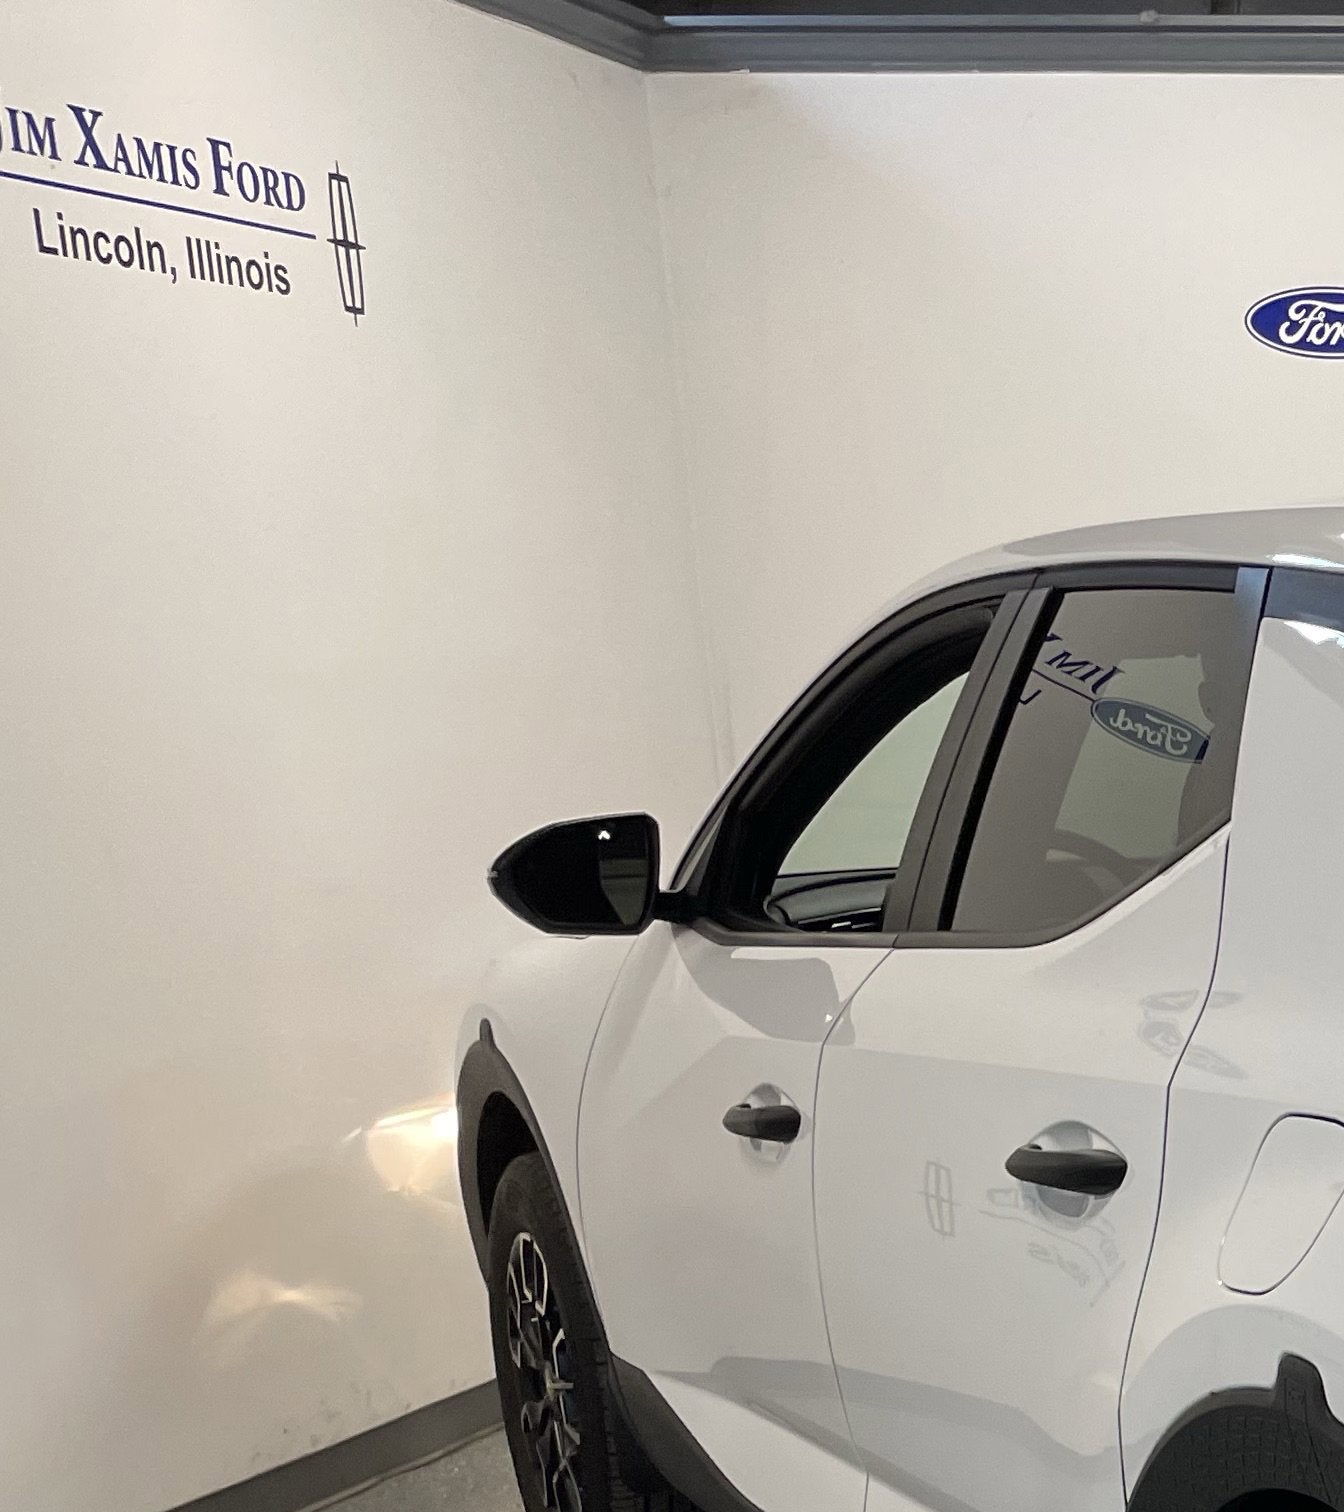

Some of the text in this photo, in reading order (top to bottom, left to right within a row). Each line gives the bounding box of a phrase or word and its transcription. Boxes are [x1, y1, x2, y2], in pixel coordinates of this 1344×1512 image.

[0, 106, 62, 161] IM
[33, 208, 291, 296] Lincoln, Illinois
